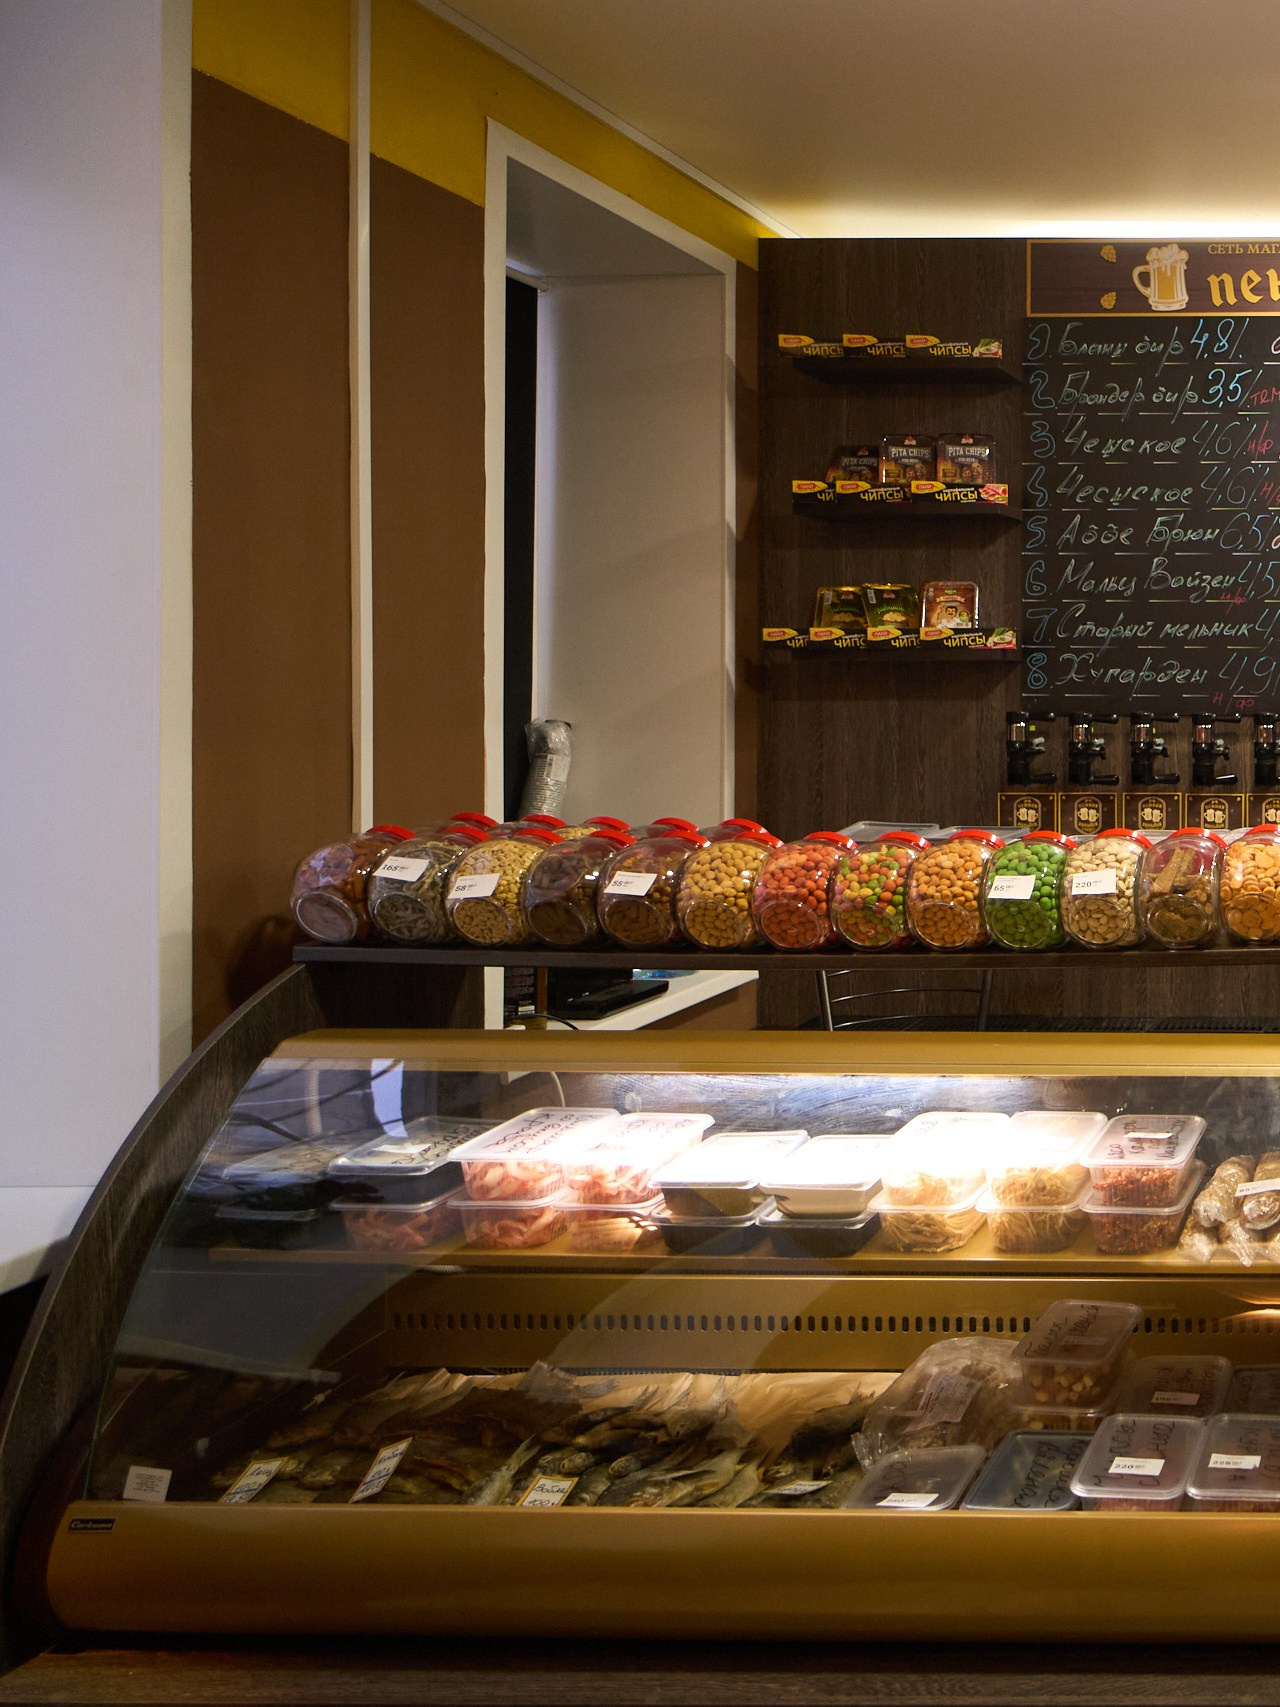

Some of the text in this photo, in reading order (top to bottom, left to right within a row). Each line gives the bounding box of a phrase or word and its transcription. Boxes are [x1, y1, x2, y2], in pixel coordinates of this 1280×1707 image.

[1207, 243, 1244, 255] СЕТЬ
[929, 344, 972, 356] ЧИПСЫ
[1136, 327, 1184, 377] бир
[1152, 375, 1198, 424] бир
[860, 490, 904, 501] ЧИПСЫ
[934, 490, 978, 501] ЧИПСЫ
[1056, 603, 1152, 652] Старый
[1159, 620, 1252, 640] мельник
[943, 636, 986, 647] ЧИПСЫ
